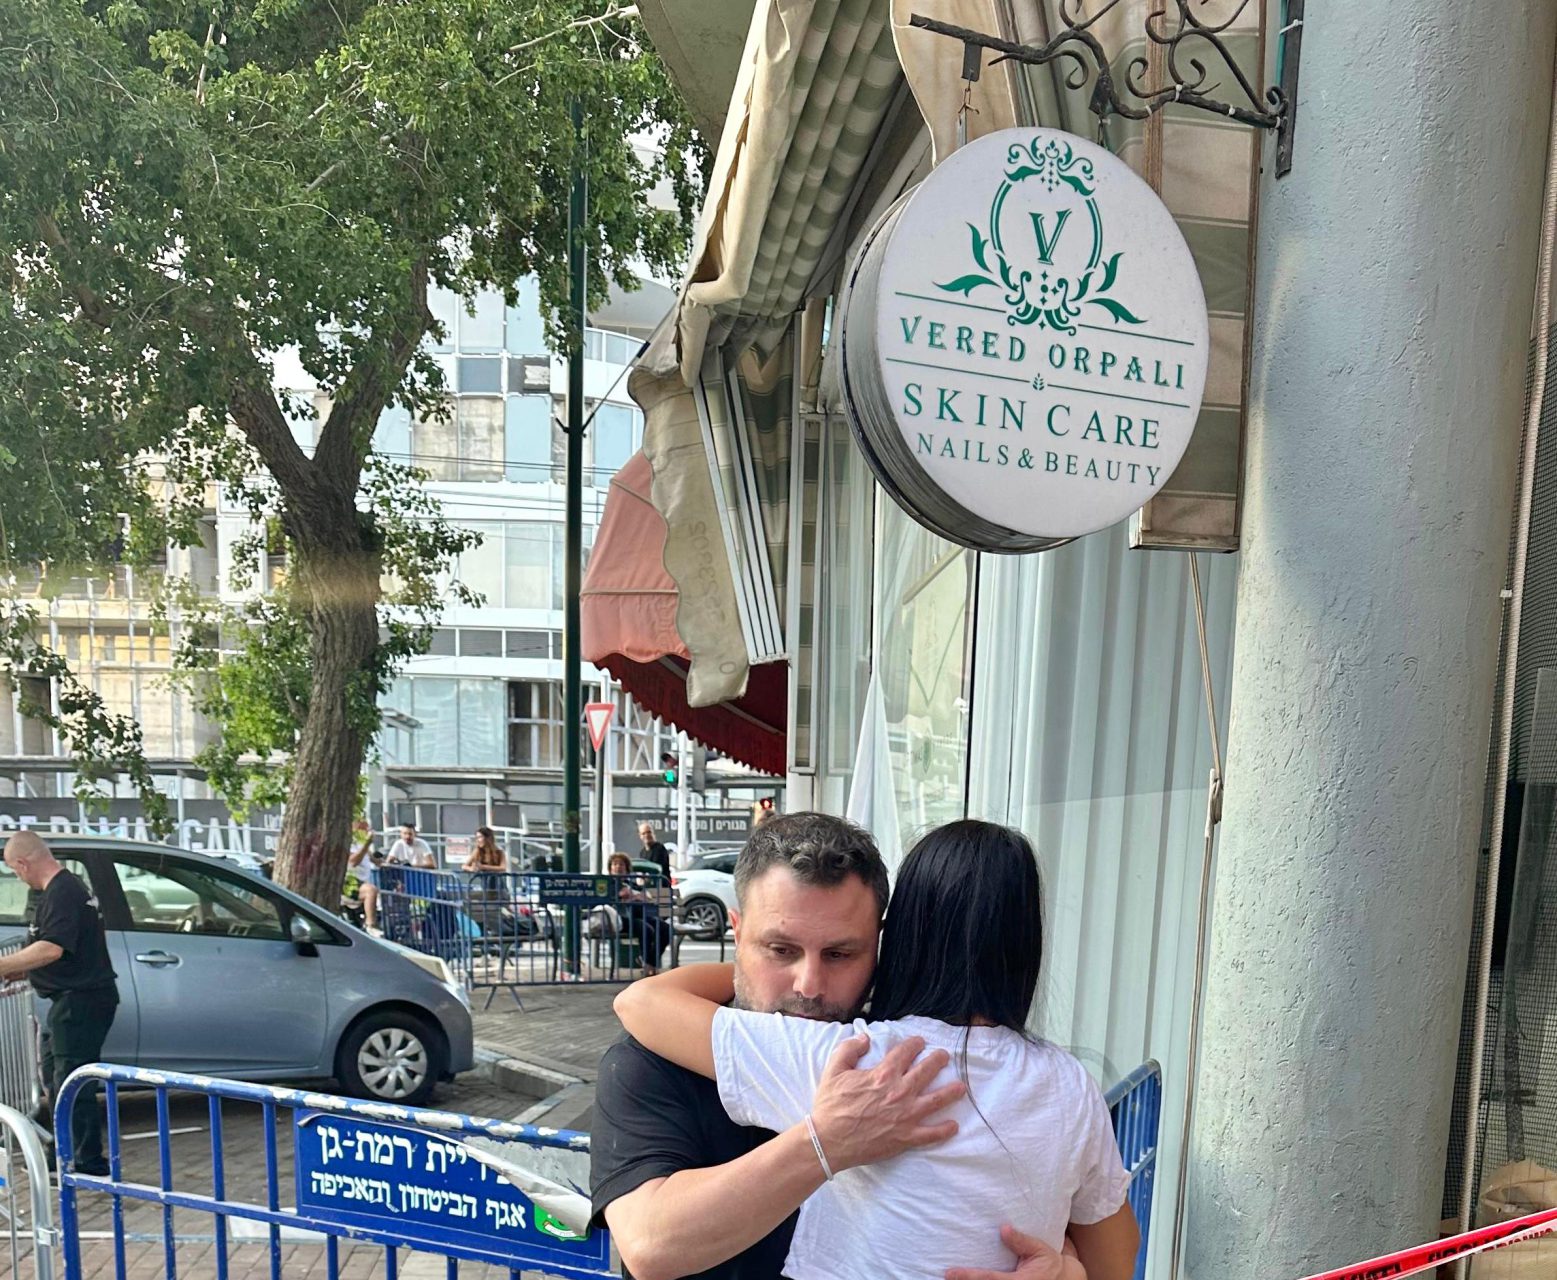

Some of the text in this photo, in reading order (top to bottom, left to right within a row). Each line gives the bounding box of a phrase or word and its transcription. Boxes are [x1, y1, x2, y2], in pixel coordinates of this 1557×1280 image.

[1028, 208, 1073, 266] V
[899, 315, 1186, 391] VERED ORPALI
[903, 382, 1162, 450] SKIN CARE
[316, 1125, 413, 1169] רמת-גן
[311, 1170, 392, 1206] והאכיפה
[398, 1183, 478, 1219] הביטחון
[485, 1198, 527, 1230] אגף
